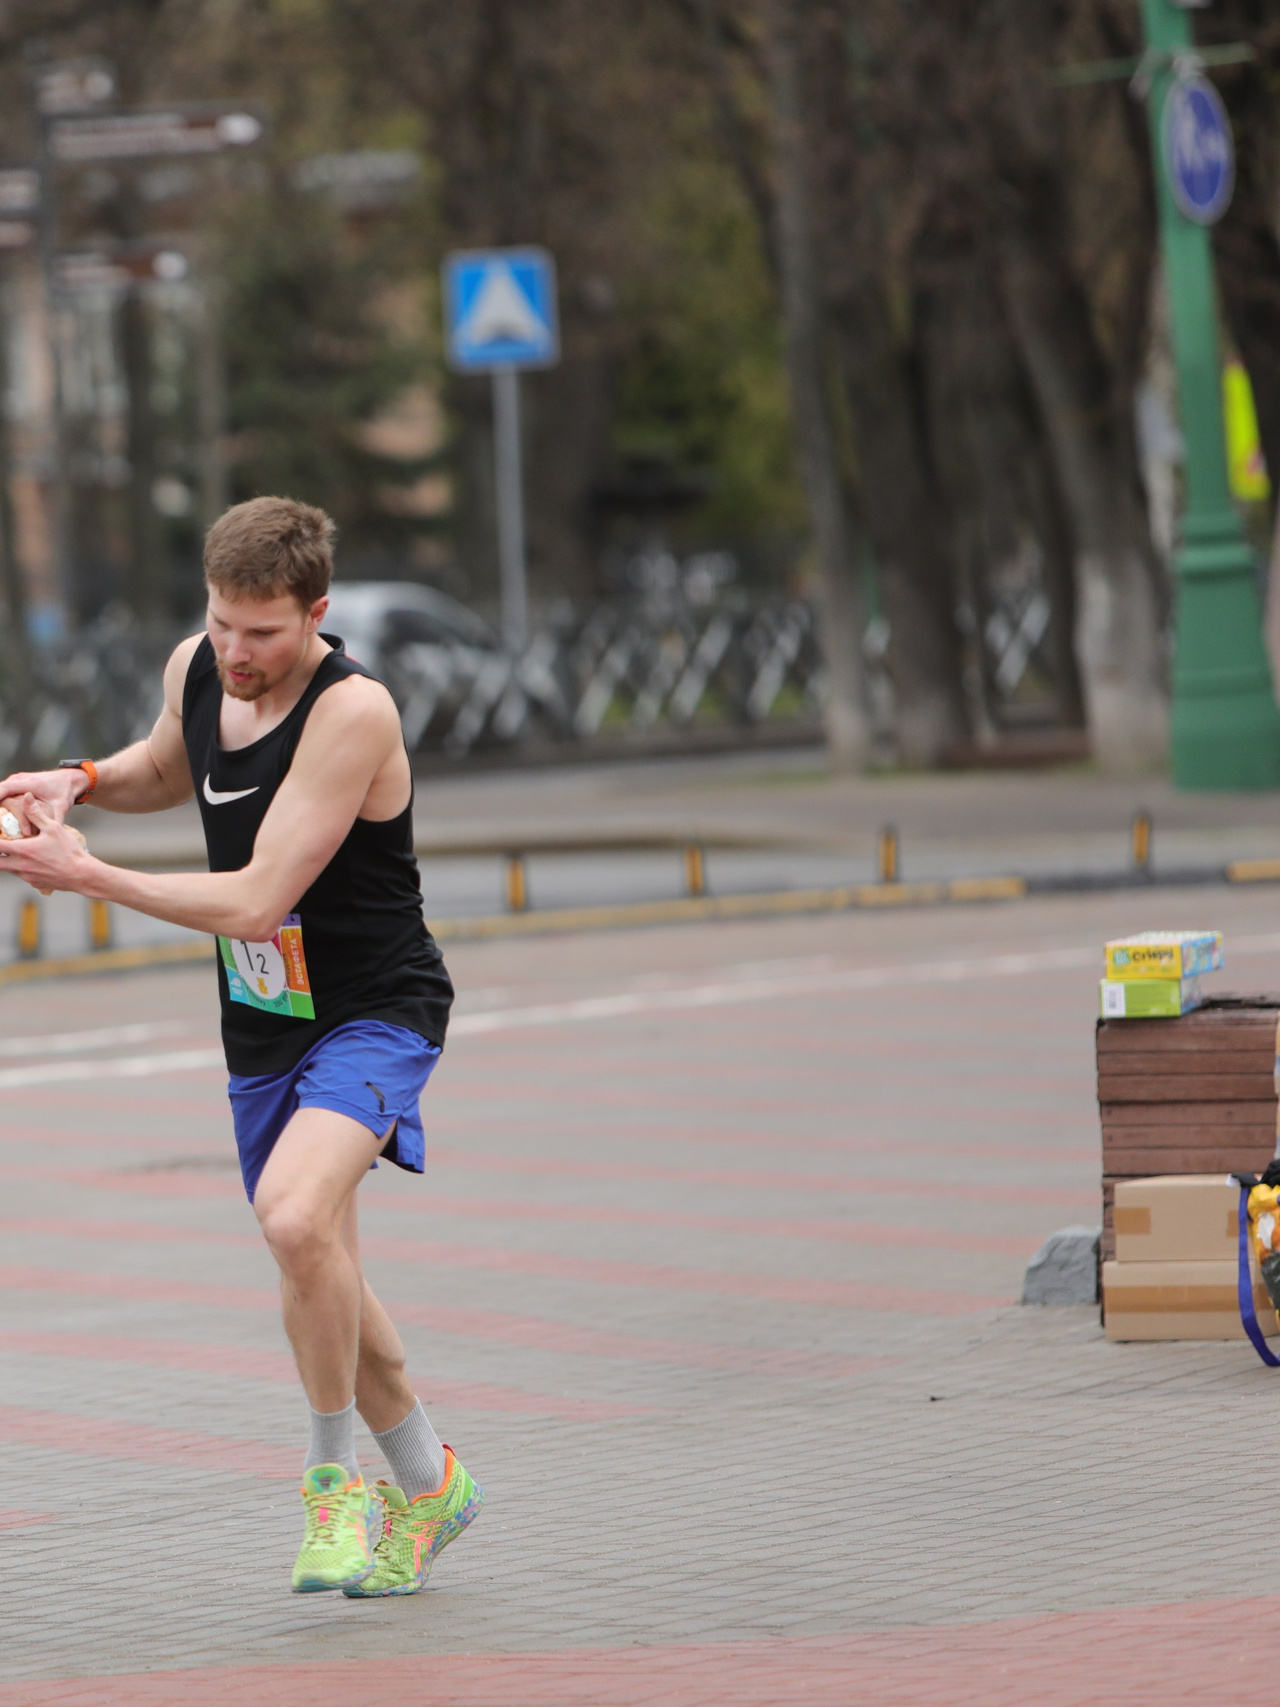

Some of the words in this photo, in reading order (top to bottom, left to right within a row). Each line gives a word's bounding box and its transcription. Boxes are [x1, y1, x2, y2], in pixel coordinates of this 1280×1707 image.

[240, 940, 254, 971] 1
[256, 953, 269, 975] 2
[291, 939, 304, 984] ЭСТАФЕТА
